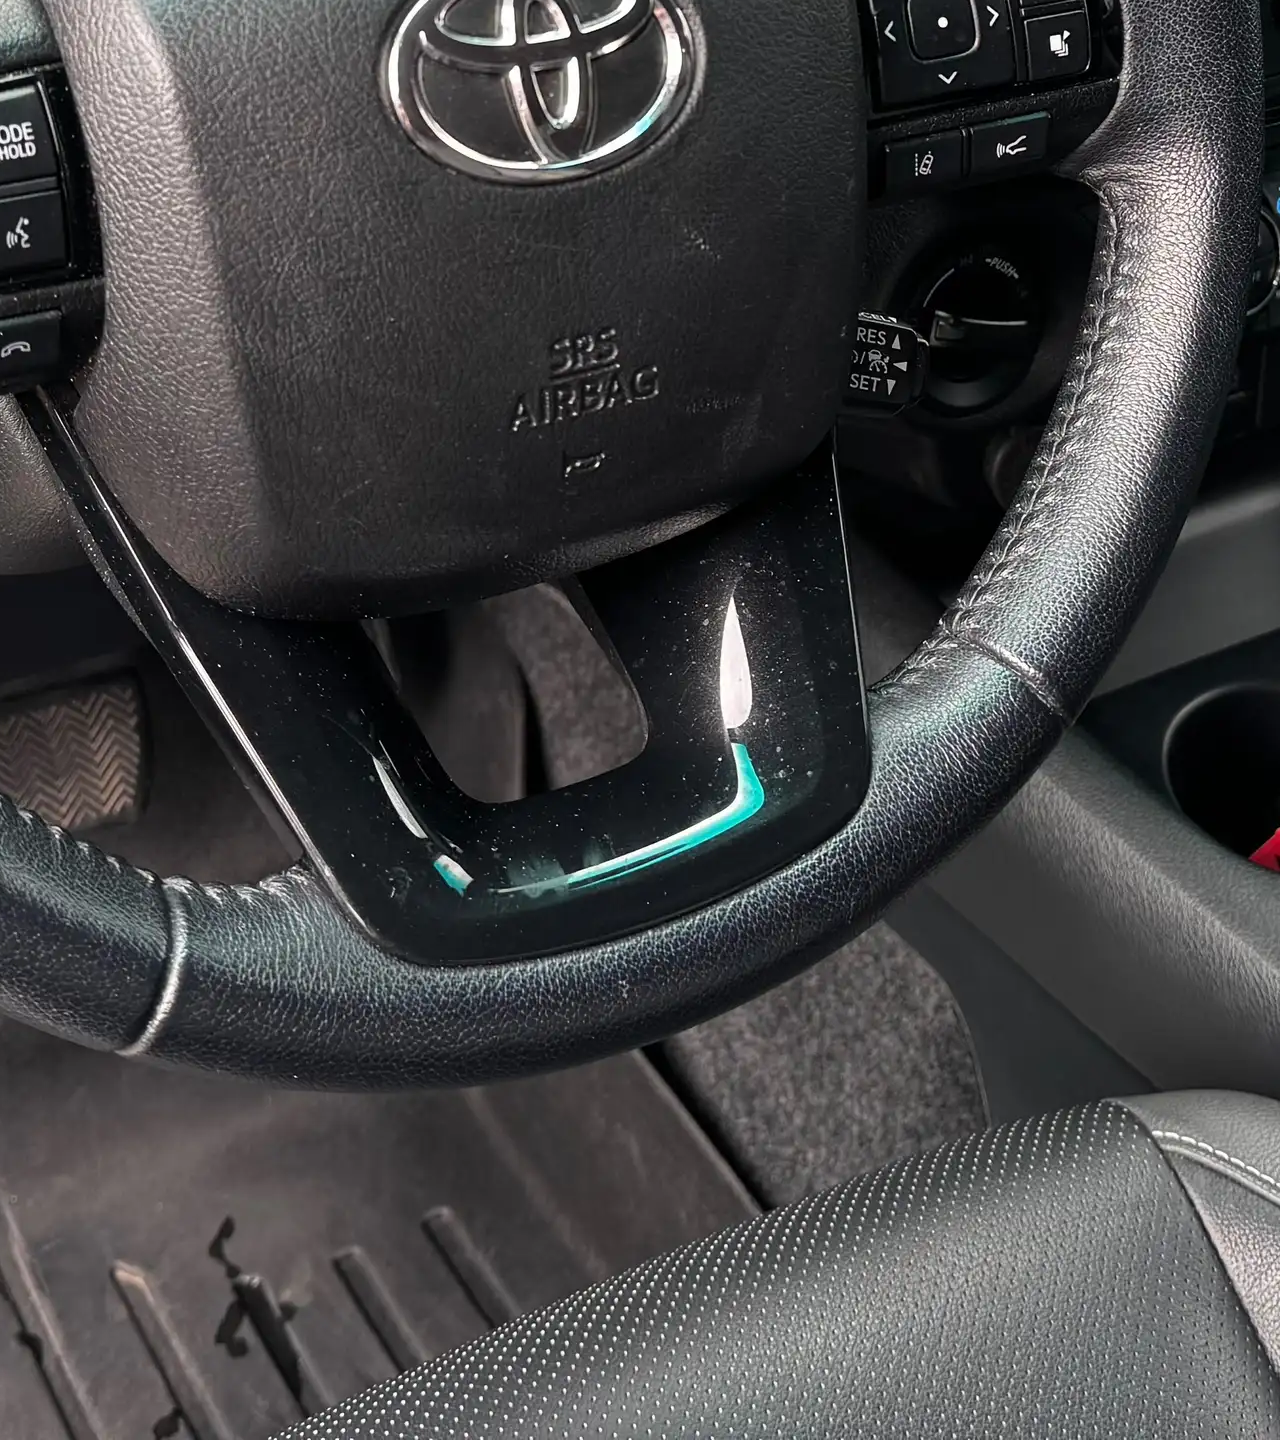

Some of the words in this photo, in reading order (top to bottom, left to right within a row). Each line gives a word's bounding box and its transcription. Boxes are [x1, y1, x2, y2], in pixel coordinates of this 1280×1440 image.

[550, 327, 620, 371] SRS
[856, 327, 887, 346] RES
[849, 373, 881, 392] SET
[510, 365, 661, 433] AIRBAG
